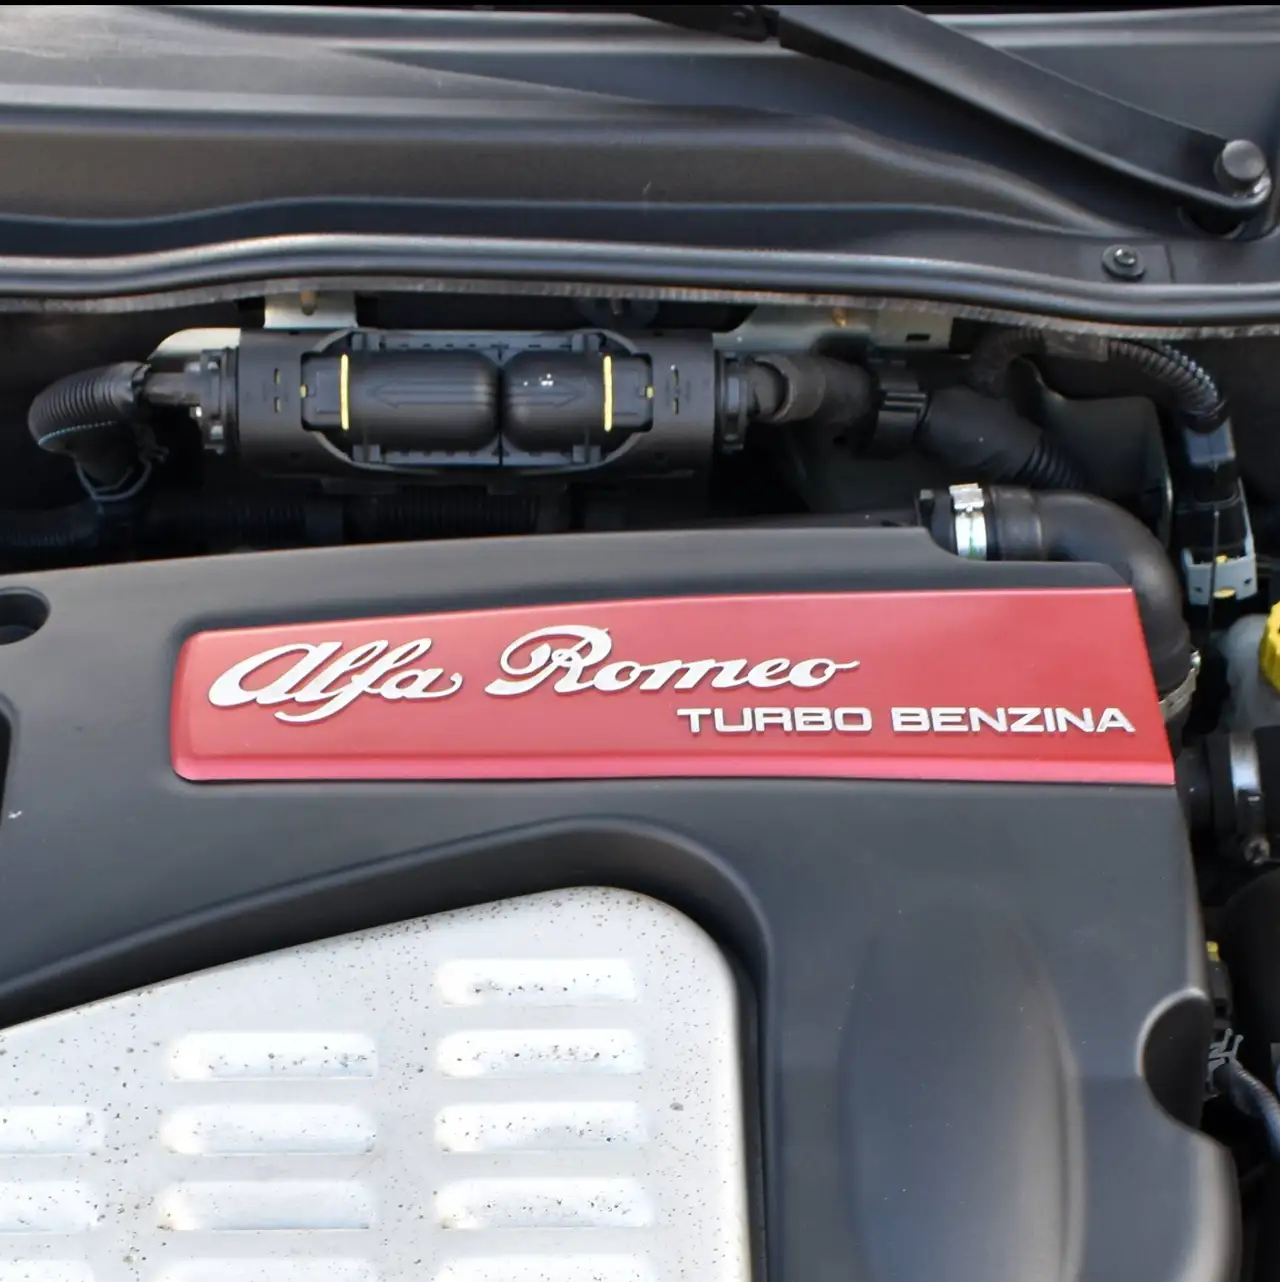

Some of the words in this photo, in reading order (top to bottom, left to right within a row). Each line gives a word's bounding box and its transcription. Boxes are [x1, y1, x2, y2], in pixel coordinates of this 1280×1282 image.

[208, 637, 463, 724] Alfa
[484, 624, 860, 695] Romeo
[677, 706, 873, 733] TURBO
[891, 706, 1136, 733] BENZINA
